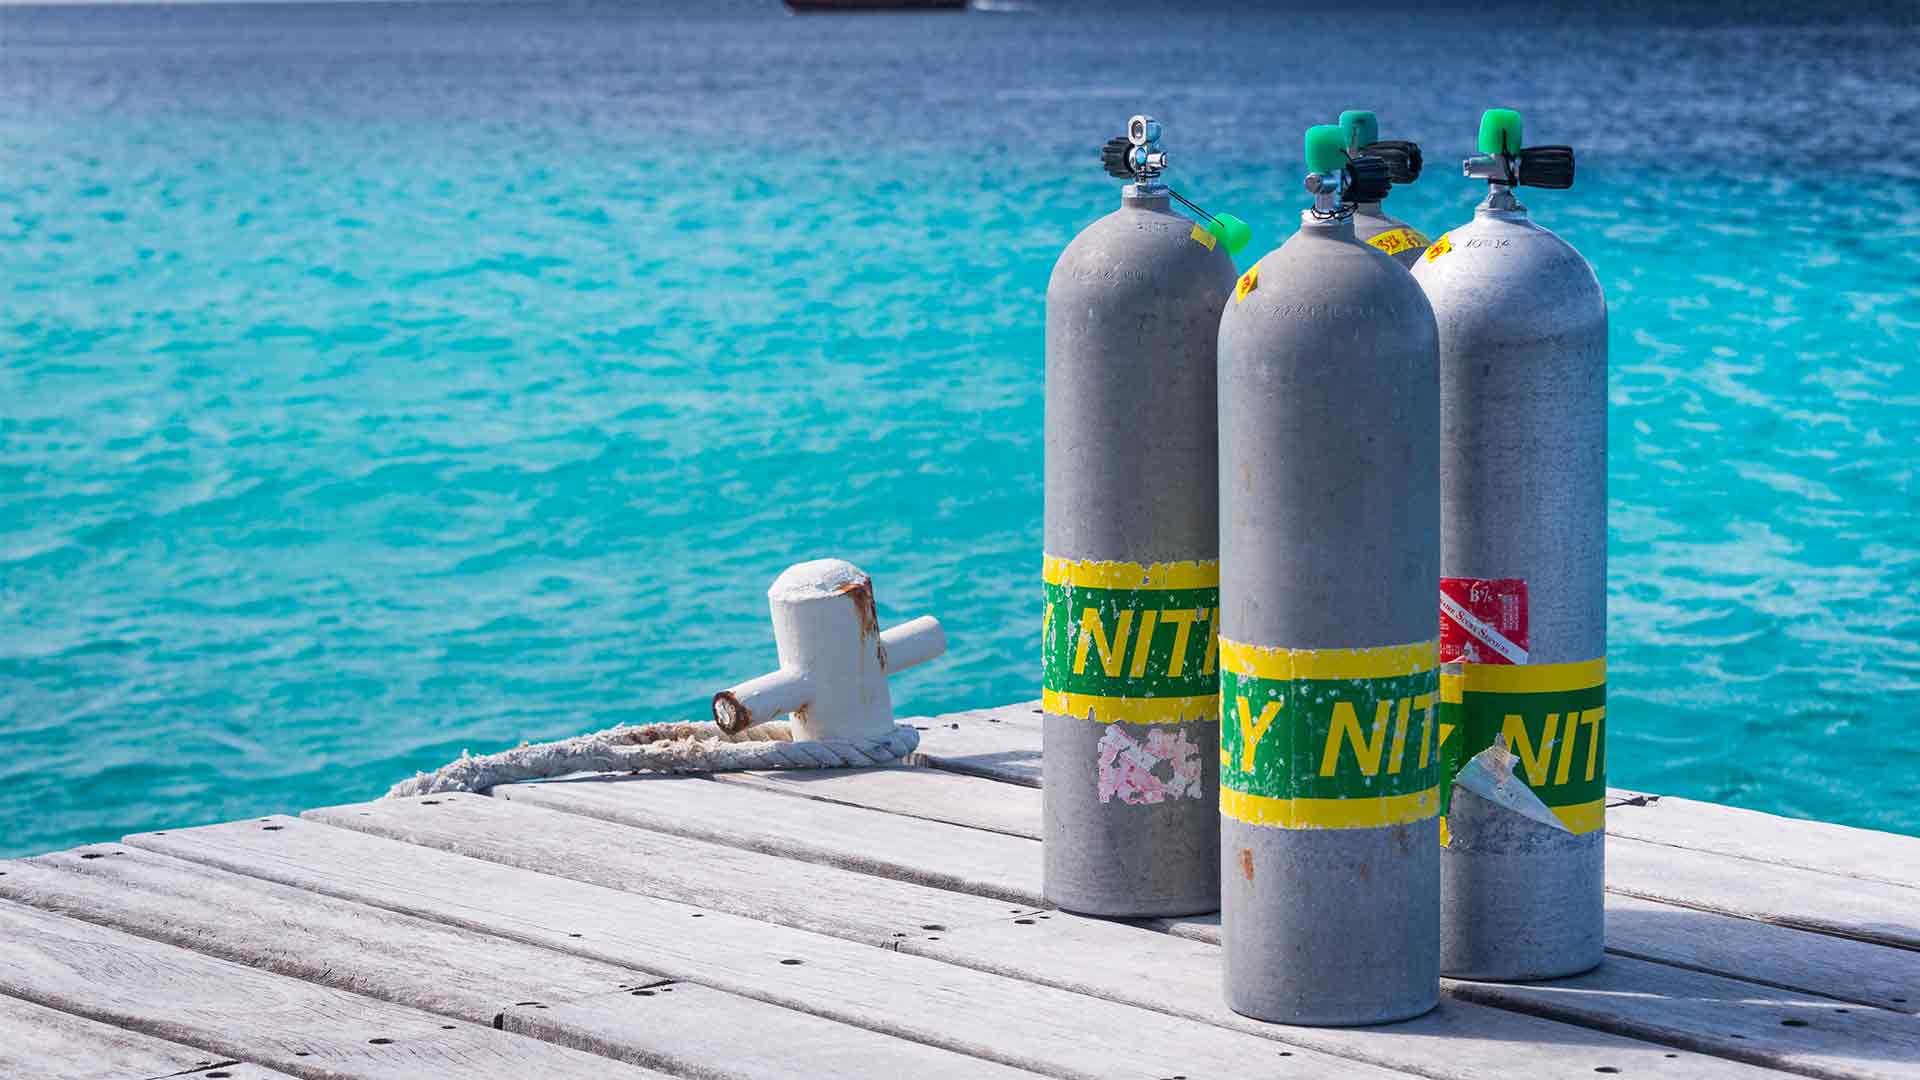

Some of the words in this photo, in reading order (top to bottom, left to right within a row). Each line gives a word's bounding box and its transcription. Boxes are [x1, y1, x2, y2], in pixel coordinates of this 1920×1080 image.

[1220, 696, 1283, 773] Y
[1319, 695, 1440, 777] NIT
[1501, 706, 1606, 786] NIT
